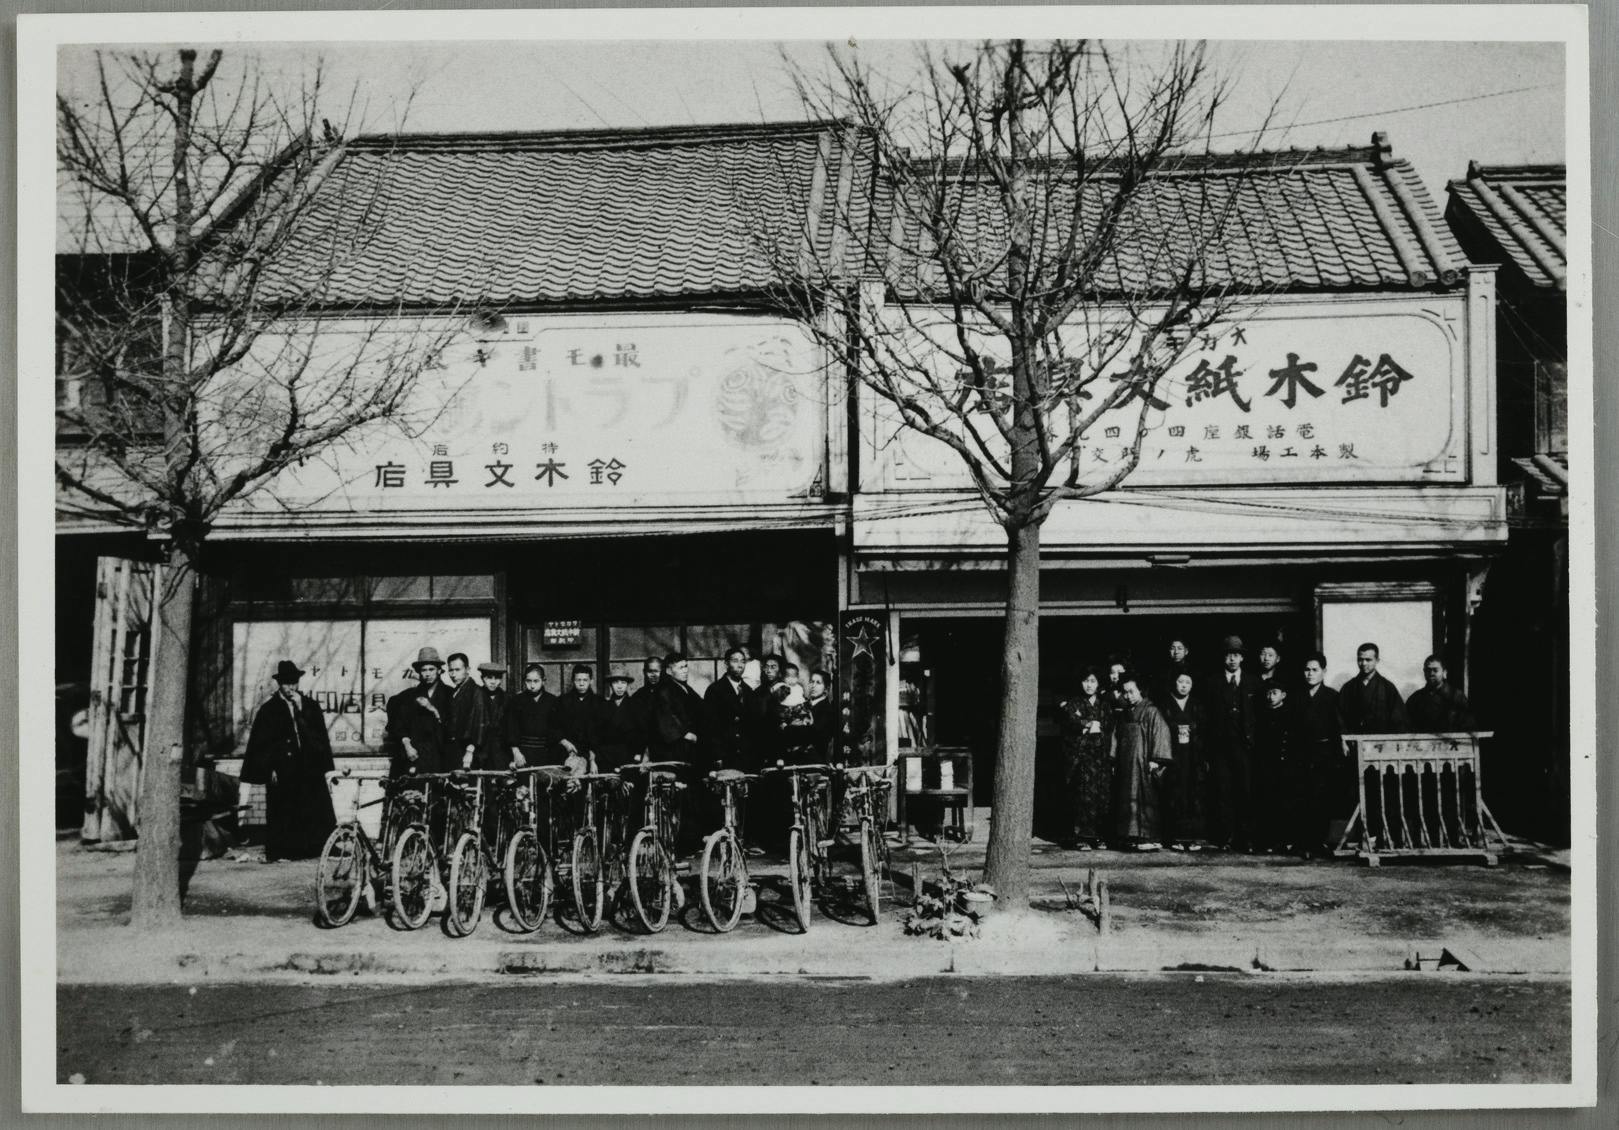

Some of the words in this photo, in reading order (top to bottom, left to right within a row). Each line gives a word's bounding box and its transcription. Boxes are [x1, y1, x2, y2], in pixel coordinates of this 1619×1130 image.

[954, 351, 1413, 414] 鈴木紙文具店
[432, 442, 558, 457] 特約店
[375, 457, 626, 488] 鈴木文具店
